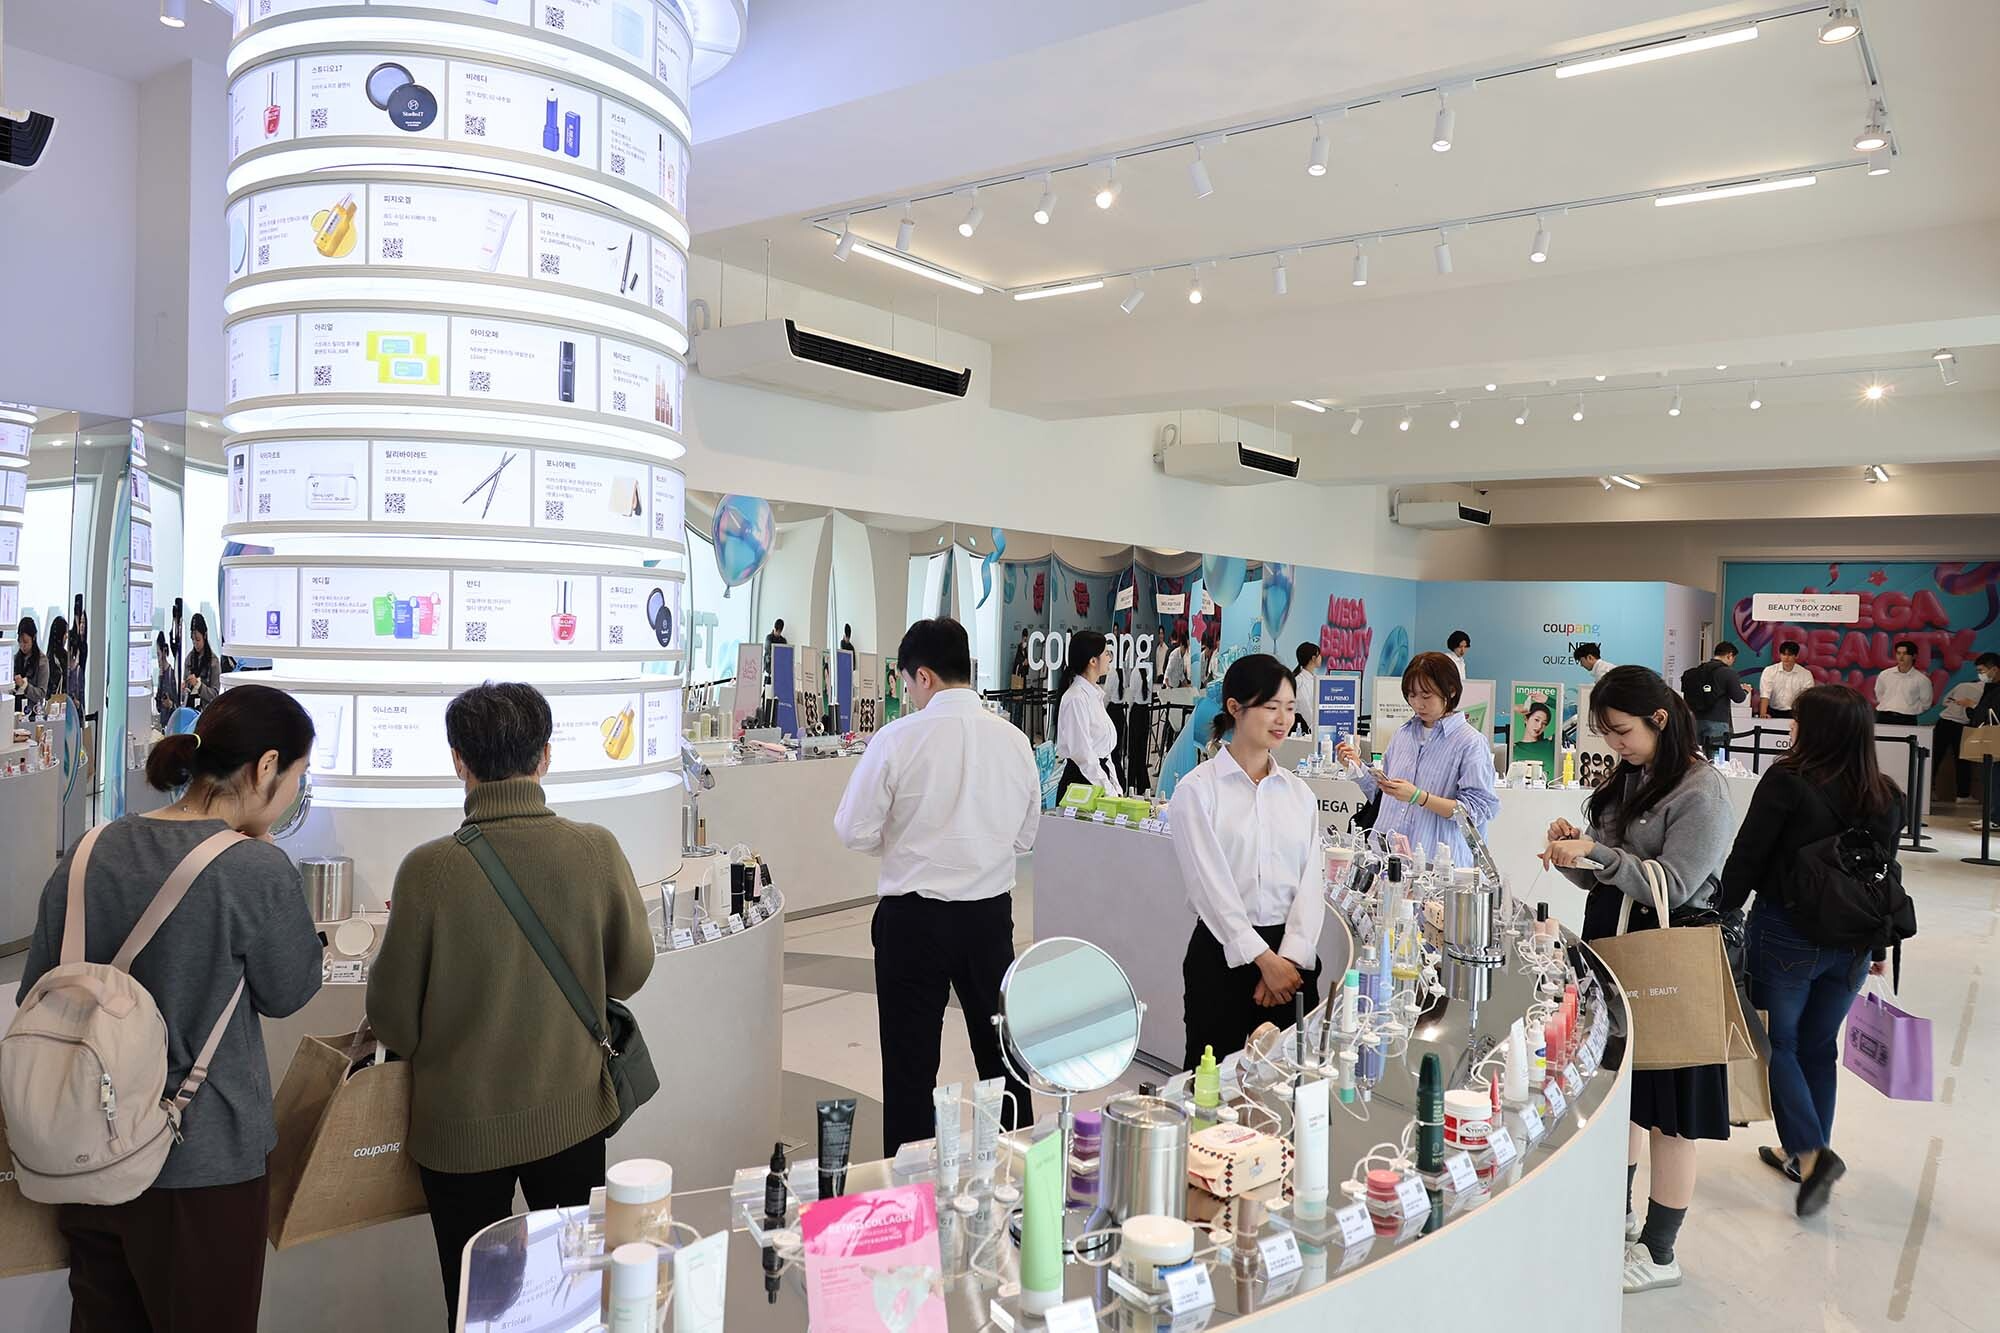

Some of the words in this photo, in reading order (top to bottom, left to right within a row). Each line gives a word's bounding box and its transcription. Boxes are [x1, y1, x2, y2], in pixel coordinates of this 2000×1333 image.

[470, 328, 499, 338] 아이오페
[1328, 593, 1367, 628] MEGA
[1820, 604, 1843, 612] ZONE
[1543, 623, 1600, 636] coupang
[1320, 624, 1373, 658] BEAUTY
[1028, 631, 1154, 682] coang
[1542, 655, 1566, 665] QUIZ
[372, 705, 408, 714] 이니스프리
[1649, 986, 1678, 997] BEAUTY
[353, 1142, 401, 1158] coupang
